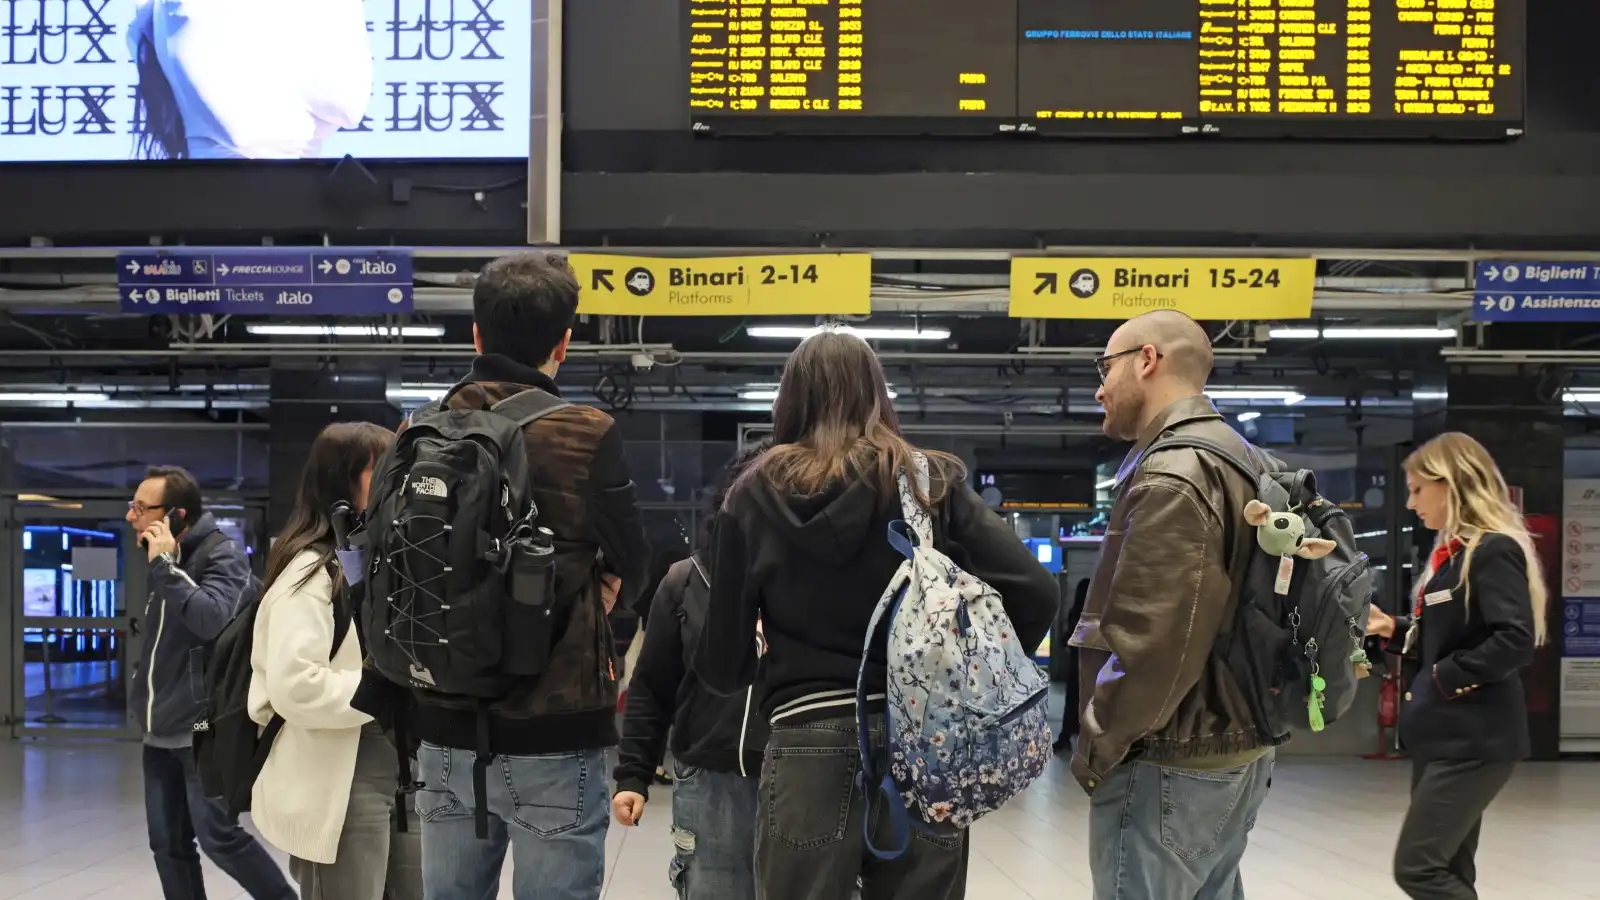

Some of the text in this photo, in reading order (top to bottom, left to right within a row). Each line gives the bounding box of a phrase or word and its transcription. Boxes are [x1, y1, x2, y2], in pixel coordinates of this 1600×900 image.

[669, 264, 818, 286] Binari 2-14
[1114, 268, 1280, 288] Binari 15-24
[1525, 266, 1587, 282] Biglietti
[166, 288, 264, 304] Biglietti Tickets
[668, 290, 733, 305] Platforms
[1112, 293, 1177, 308] Platforms
[980, 474, 995, 485] 14
[1371, 475, 1386, 486] 15
[416, 487, 436, 495] FACE
